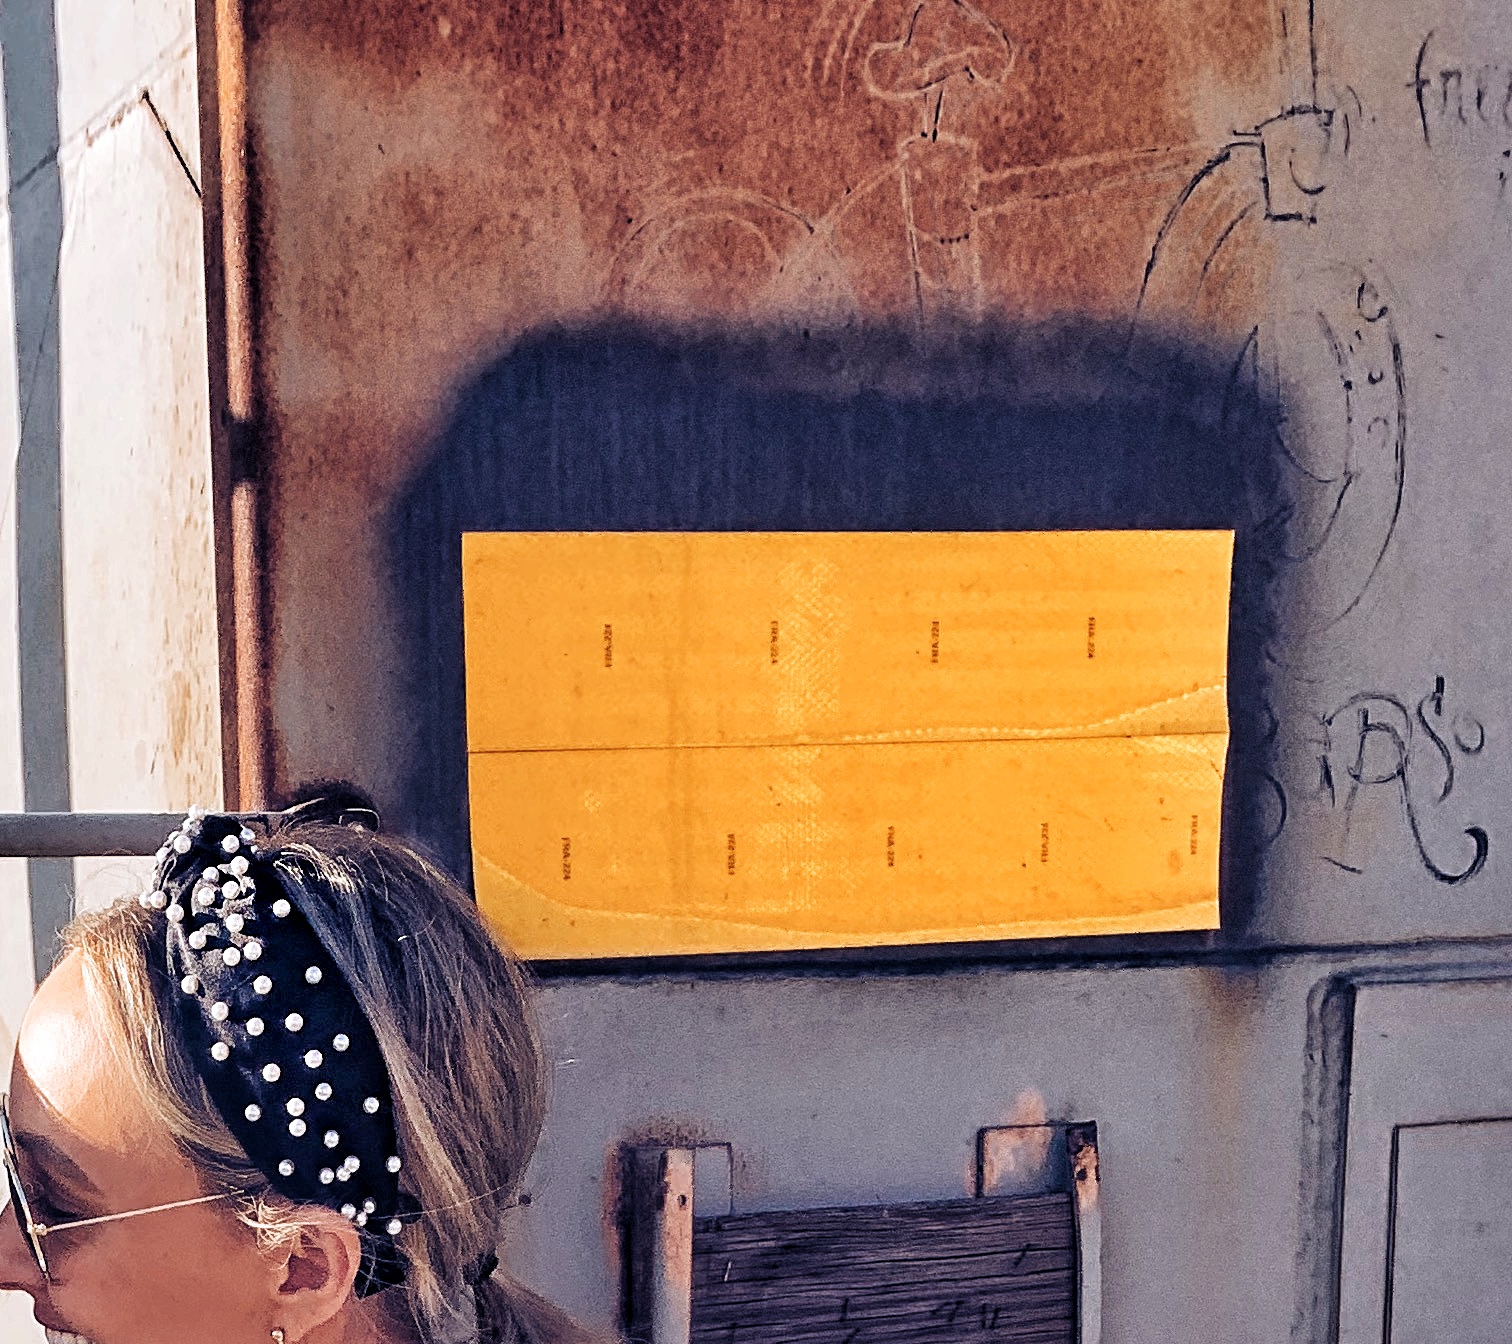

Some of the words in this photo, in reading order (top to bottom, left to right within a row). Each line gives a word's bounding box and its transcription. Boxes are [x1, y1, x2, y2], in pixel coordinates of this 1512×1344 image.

[603, 623, 613, 668] FRA-224
[930, 620, 940, 664] FRA-224
[1087, 616, 1096, 660] FRA-224
[561, 837, 571, 882] FRA-224
